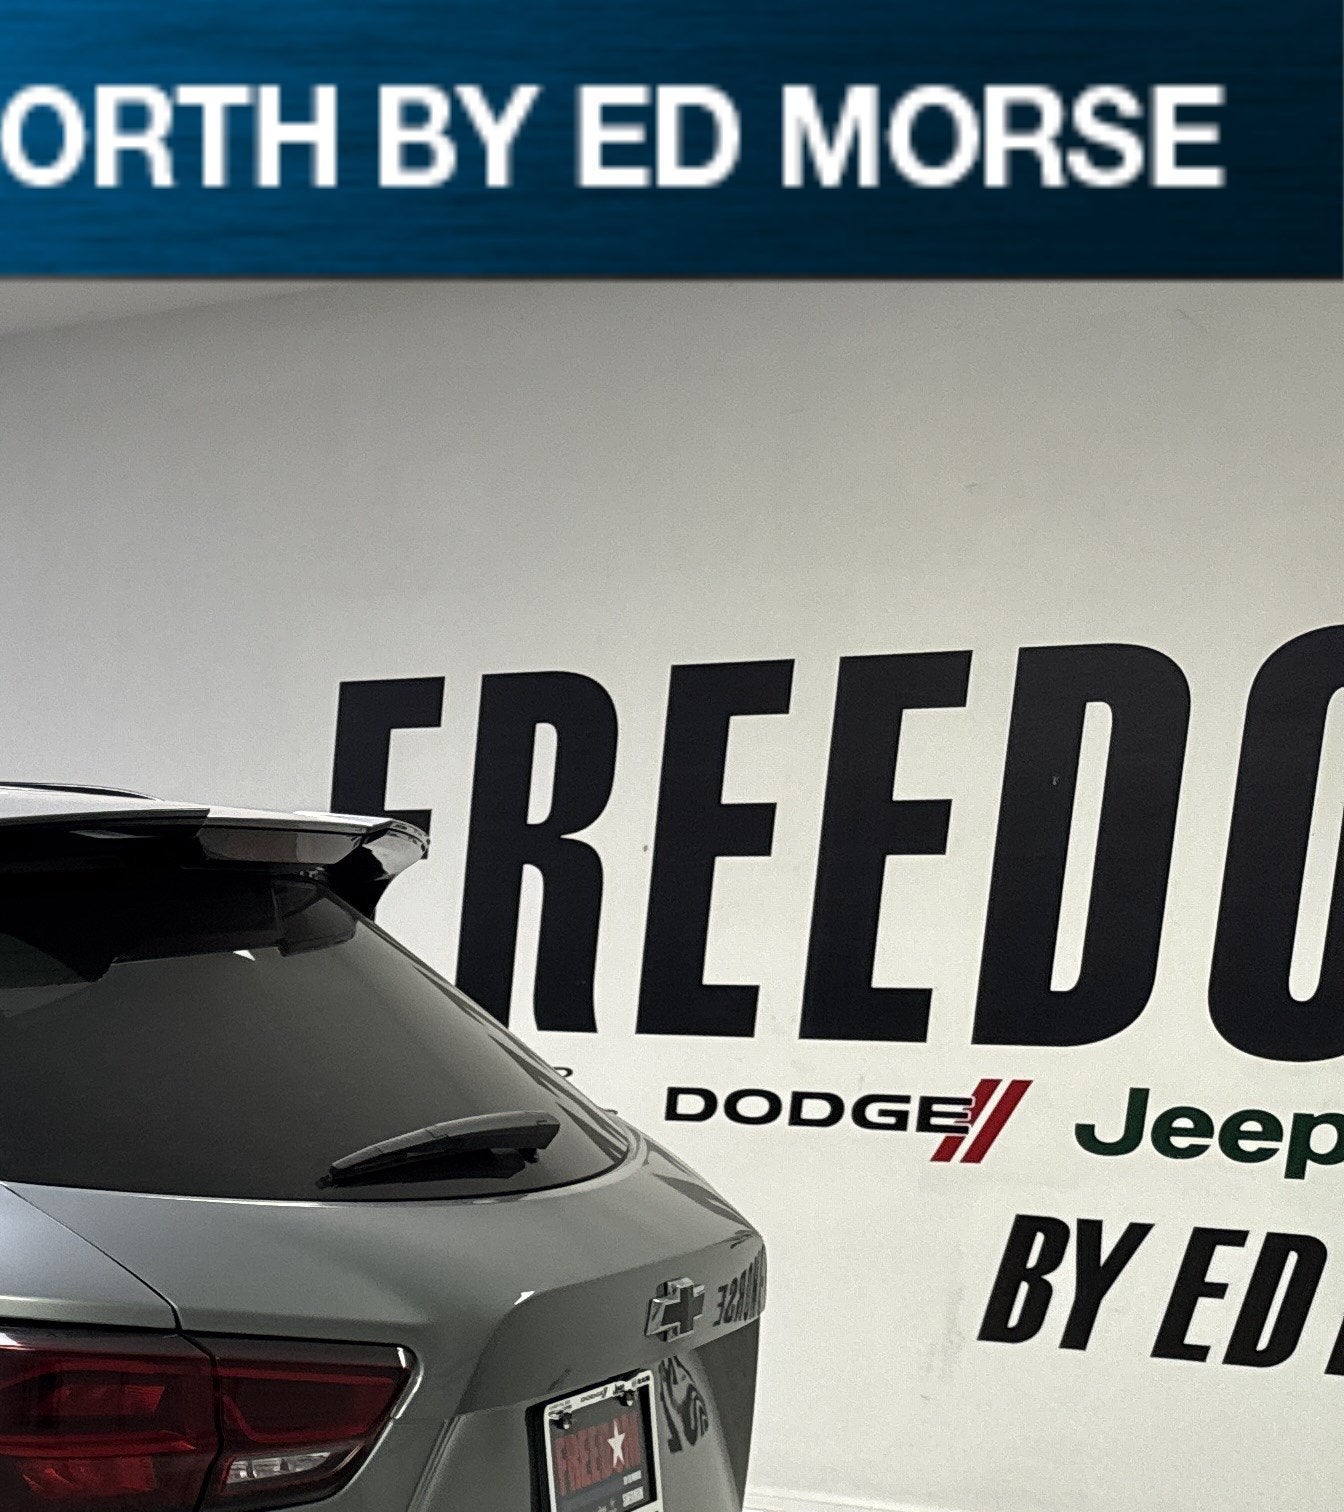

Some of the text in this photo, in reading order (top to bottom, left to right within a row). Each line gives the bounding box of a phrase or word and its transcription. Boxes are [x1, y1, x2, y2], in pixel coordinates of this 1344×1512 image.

[664, 1086, 973, 1135] DODGE
[1074, 1087, 1344, 1180] Jeep
[978, 1214, 1156, 1351] BY
[1150, 1226, 1328, 1368] ED
